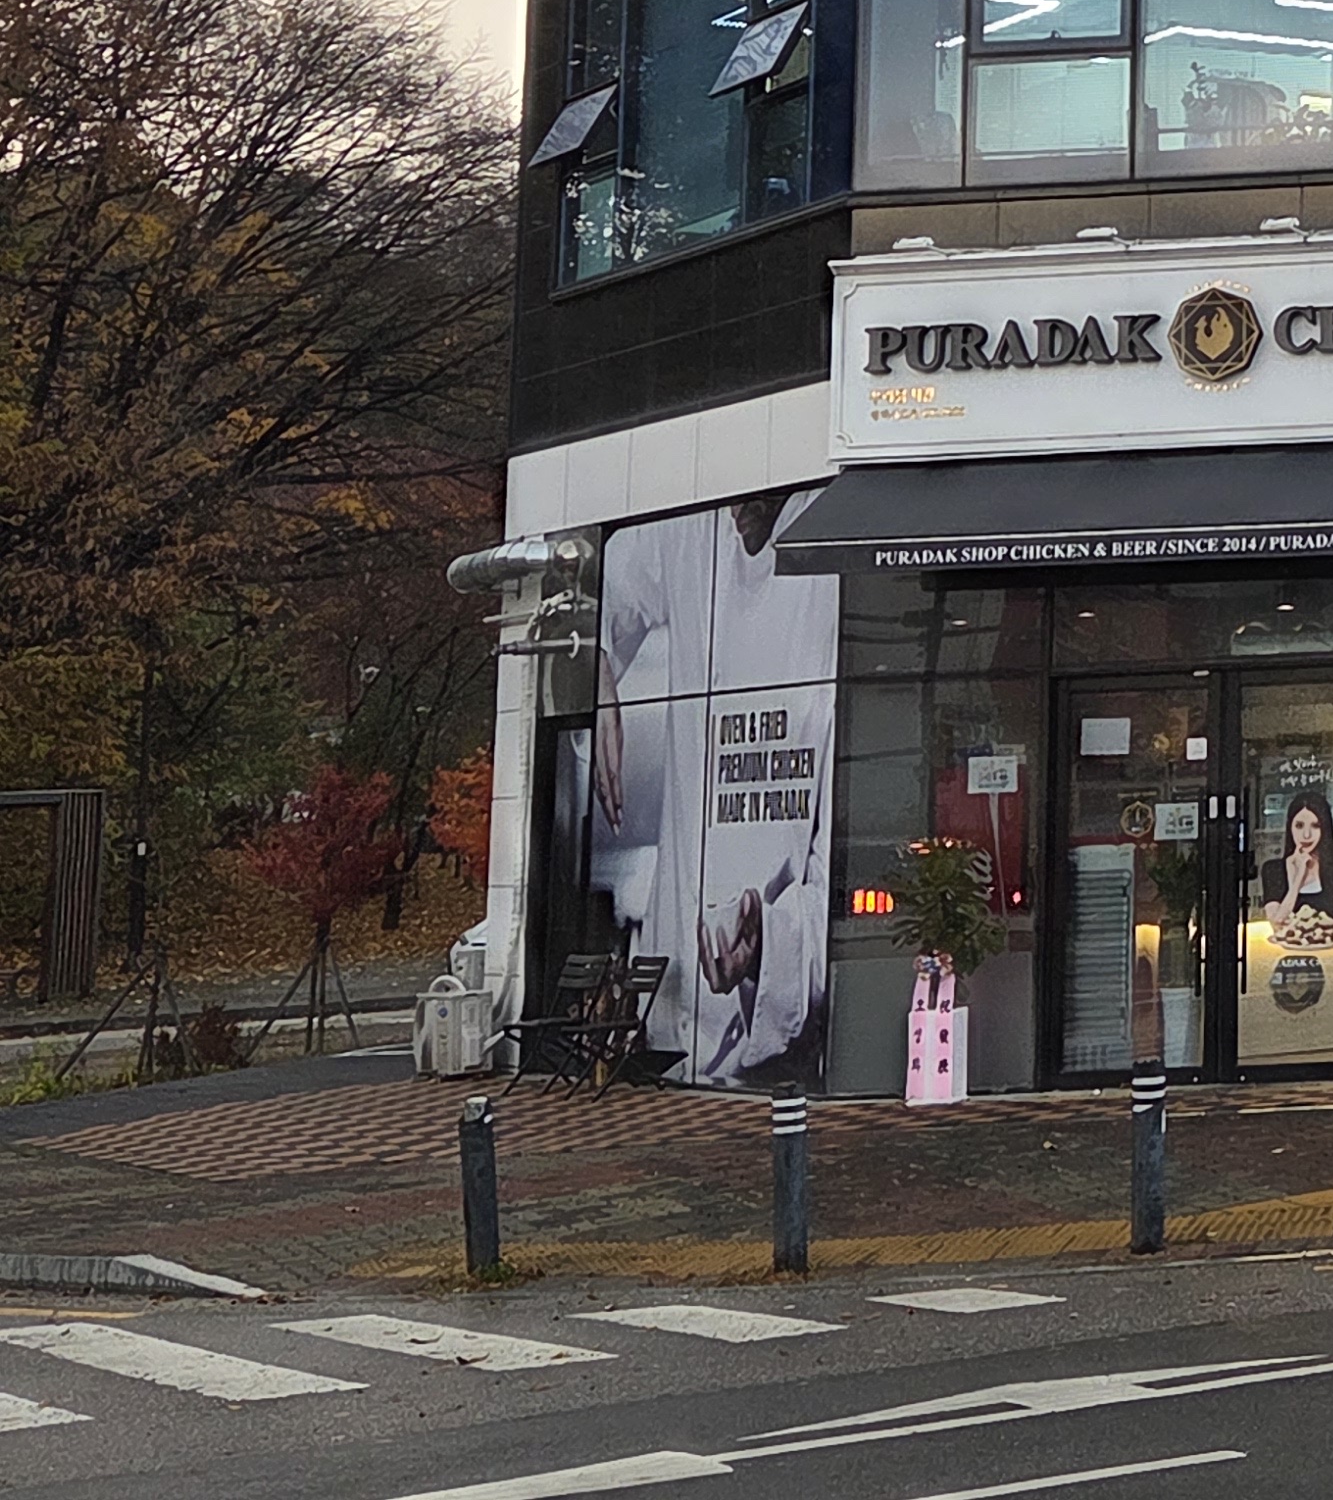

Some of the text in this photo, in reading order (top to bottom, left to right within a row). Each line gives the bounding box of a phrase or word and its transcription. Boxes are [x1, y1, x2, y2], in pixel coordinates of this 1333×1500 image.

[864, 314, 1162, 376] PURADAK
[875, 548, 958, 567] PURADAK
[960, 545, 1008, 563] SHOP
[1009, 542, 1090, 561] CHICKEN
[1093, 542, 1107, 558] &
[1112, 540, 1158, 557] BEER
[1222, 536, 1257, 552] 2014
